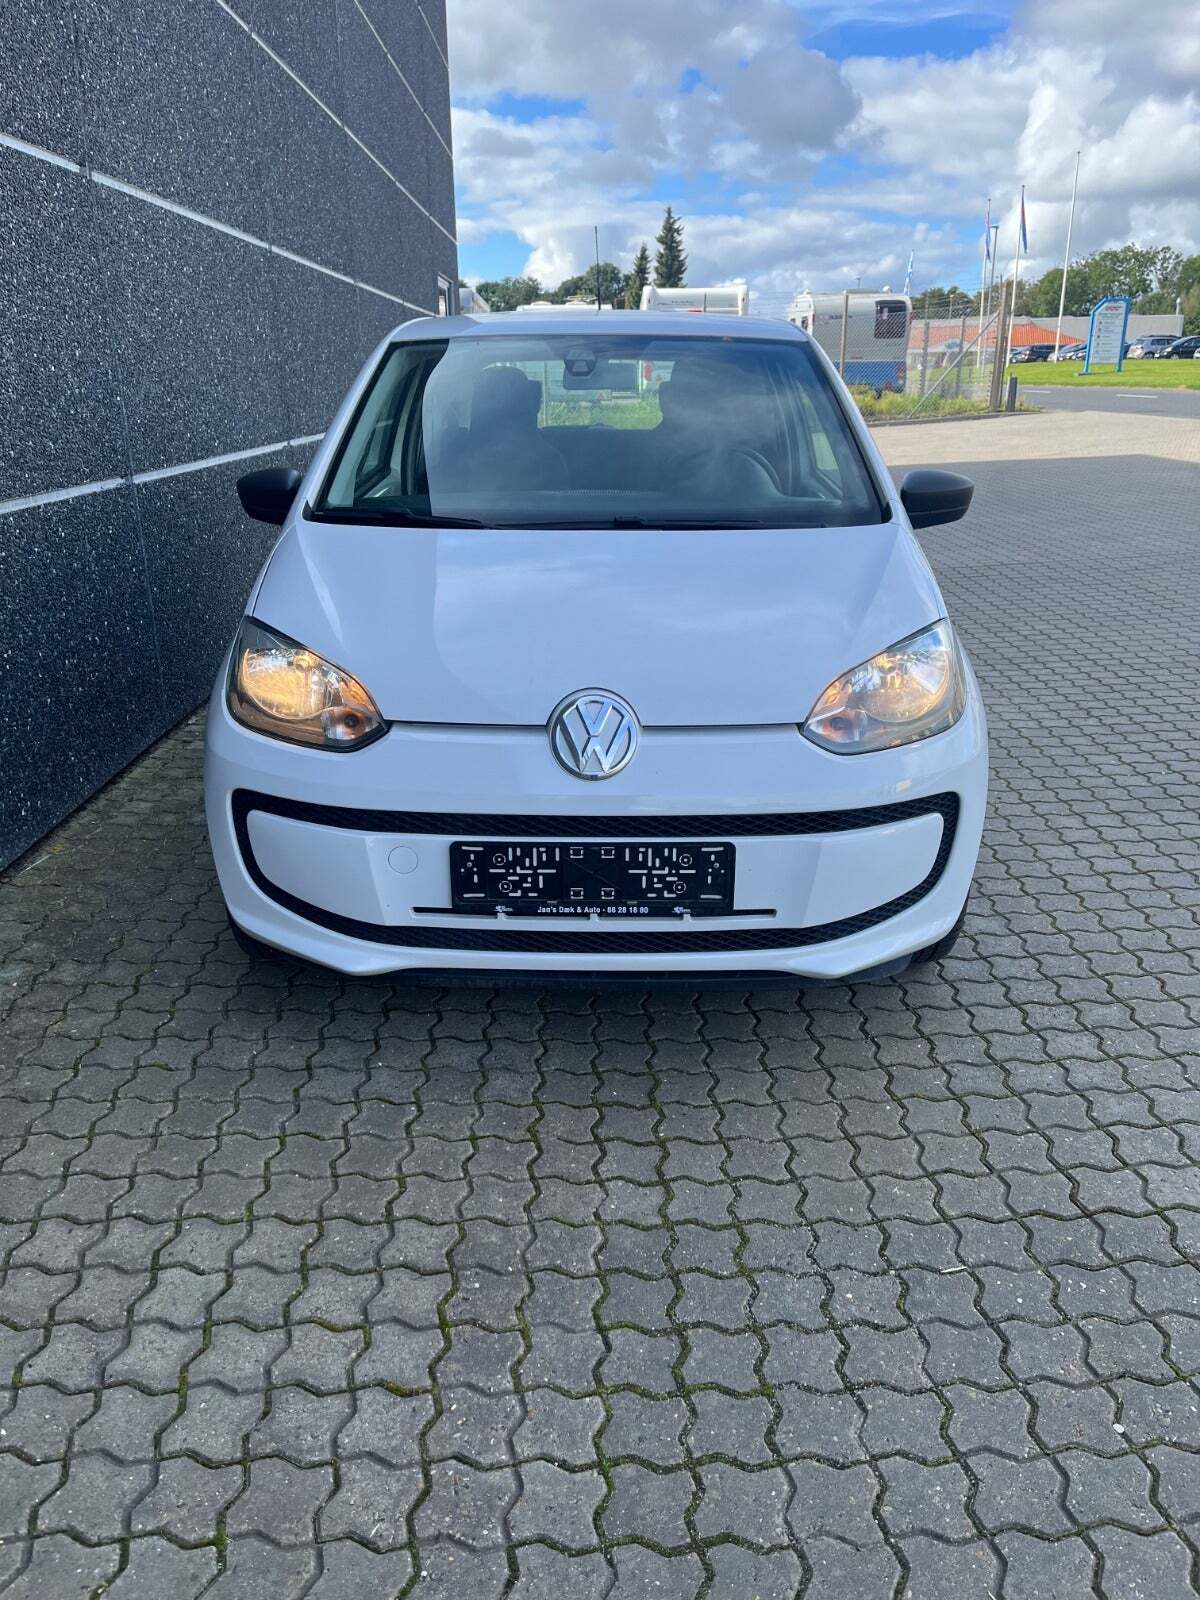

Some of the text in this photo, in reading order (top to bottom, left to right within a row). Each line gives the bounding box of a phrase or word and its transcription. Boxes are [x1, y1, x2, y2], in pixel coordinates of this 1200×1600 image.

[553, 692, 635, 777] VW
[537, 906, 557, 914] Jan's
[576, 906, 582, 914] &
[583, 906, 600, 914] Auto
